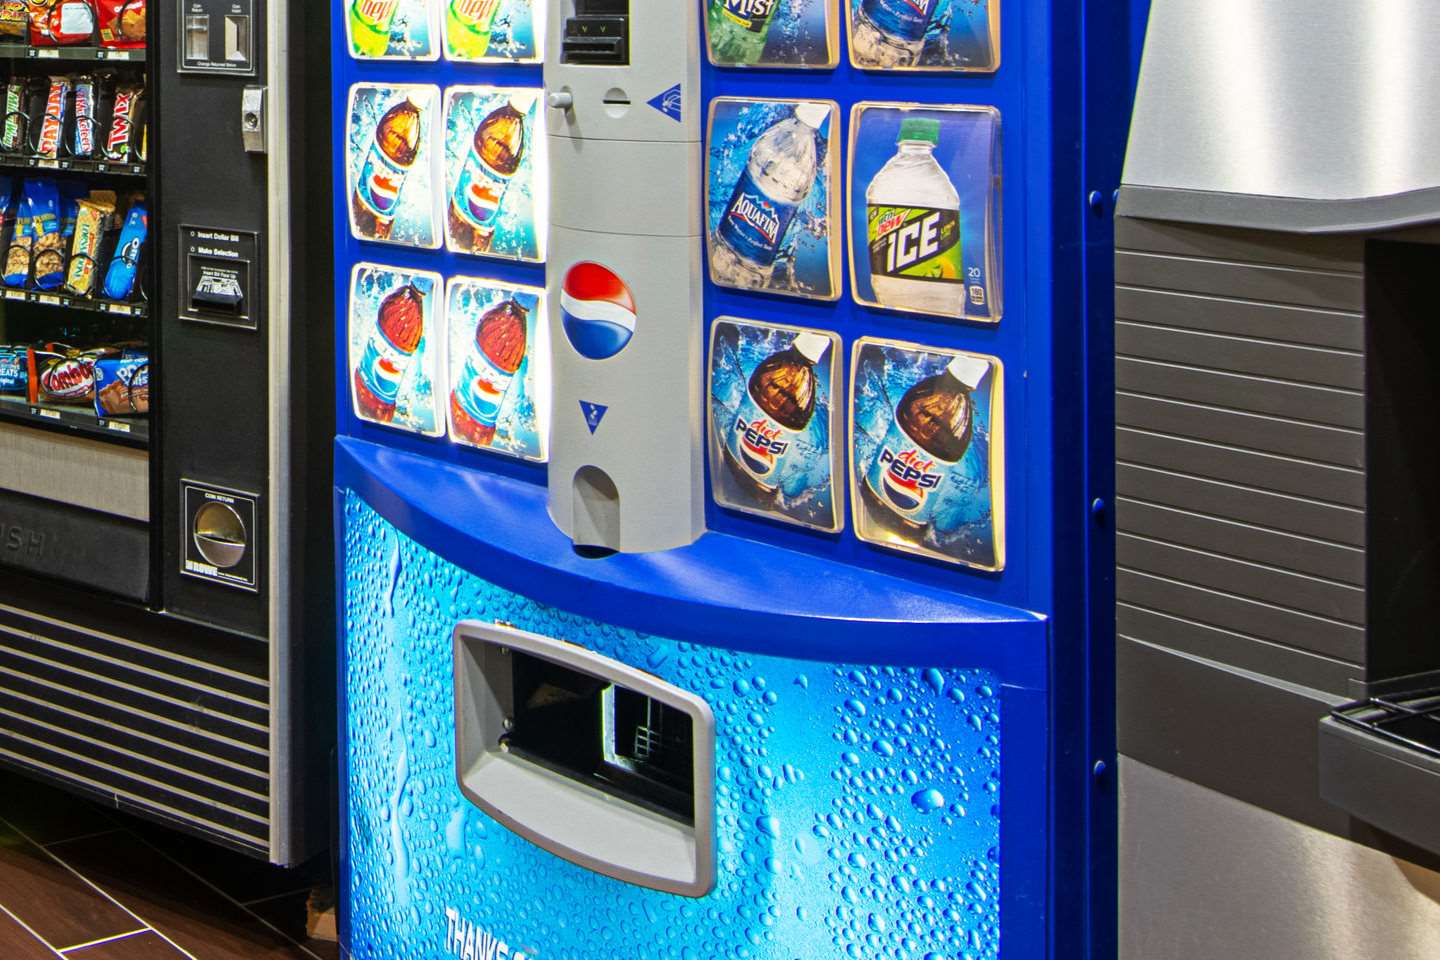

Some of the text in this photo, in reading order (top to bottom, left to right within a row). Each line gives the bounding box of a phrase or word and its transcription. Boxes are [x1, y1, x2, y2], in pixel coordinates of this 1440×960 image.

[886, 211, 941, 273] ICE
[968, 267, 980, 278] 20
[735, 417, 787, 456] PEPSI
[750, 418, 783, 440] diet
[879, 447, 941, 489] PEPSI
[897, 449, 934, 472] diet
